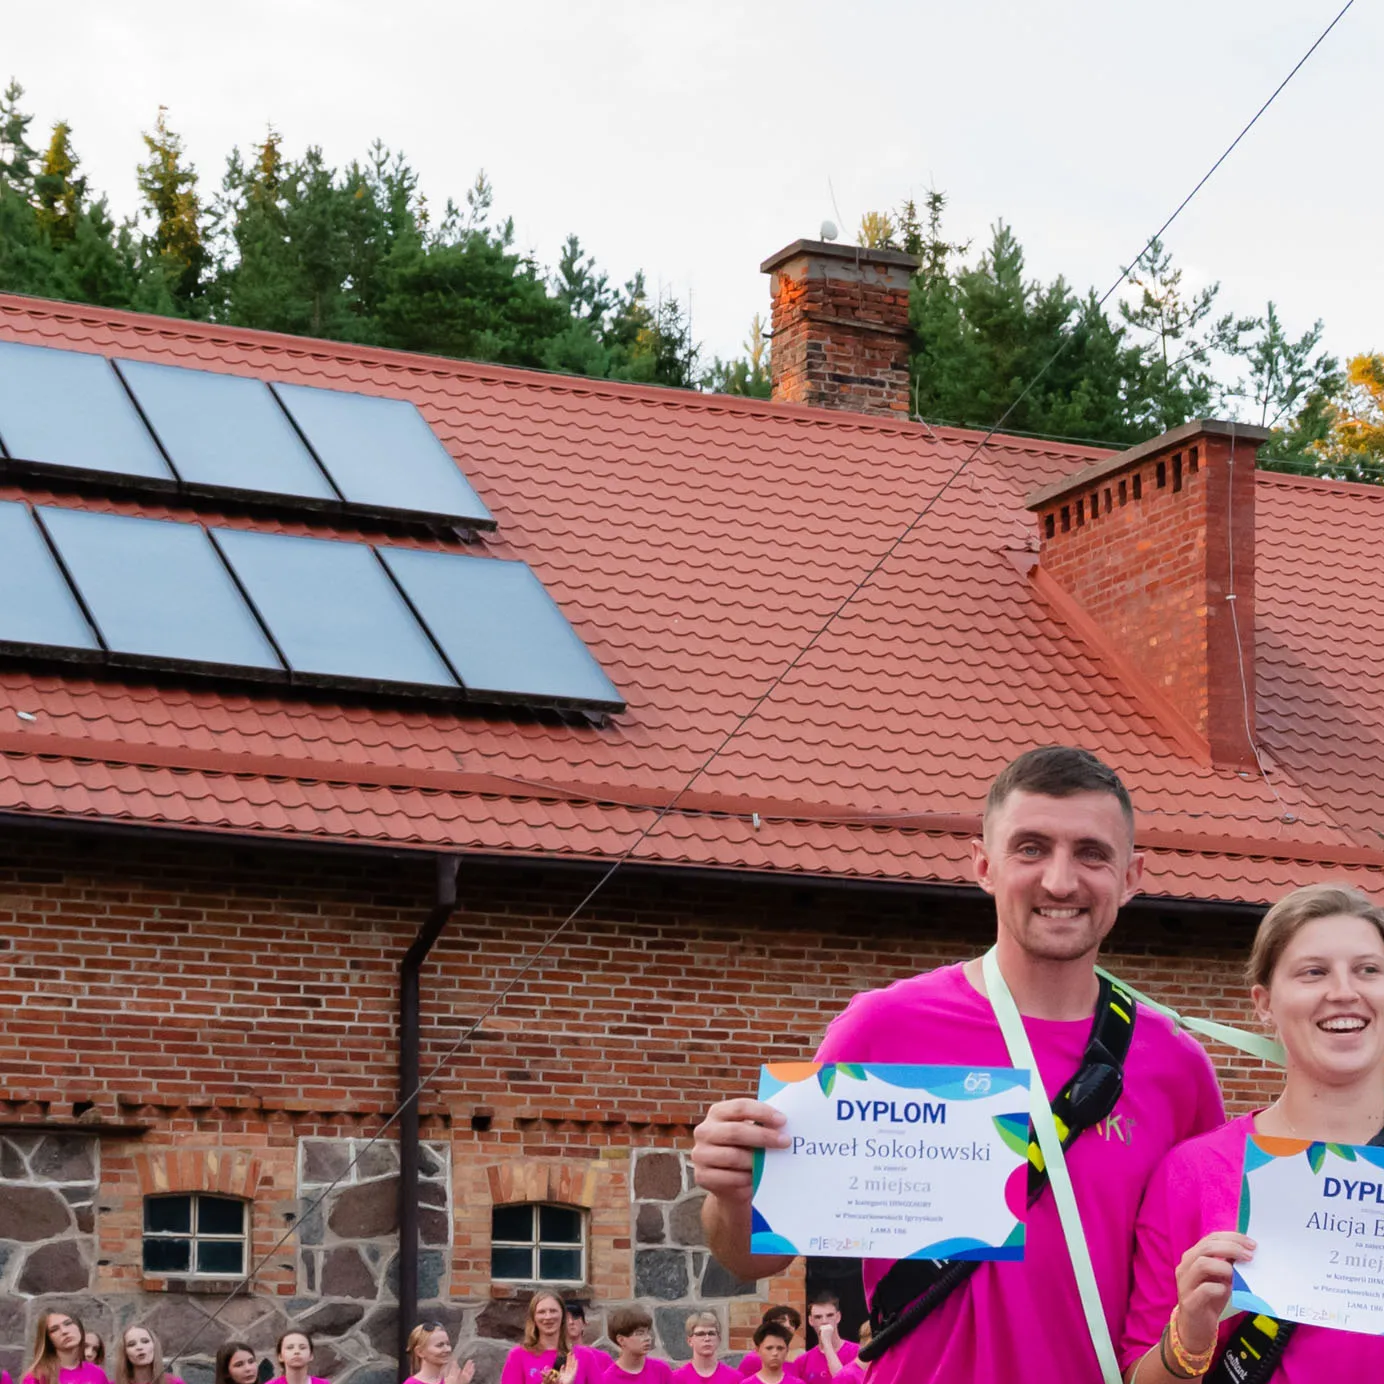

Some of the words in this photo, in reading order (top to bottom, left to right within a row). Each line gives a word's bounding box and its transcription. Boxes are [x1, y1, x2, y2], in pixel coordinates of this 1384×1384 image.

[836, 1099, 947, 1125] DYPLOM
[792, 1136, 859, 1157] Paweł
[864, 1137, 991, 1161] Sokołowski
[849, 1176, 859, 1190] 2
[864, 1177, 931, 1194] miejsca
[1305, 1211, 1366, 1238] Alicja
[1329, 1250, 1340, 1264] 2
